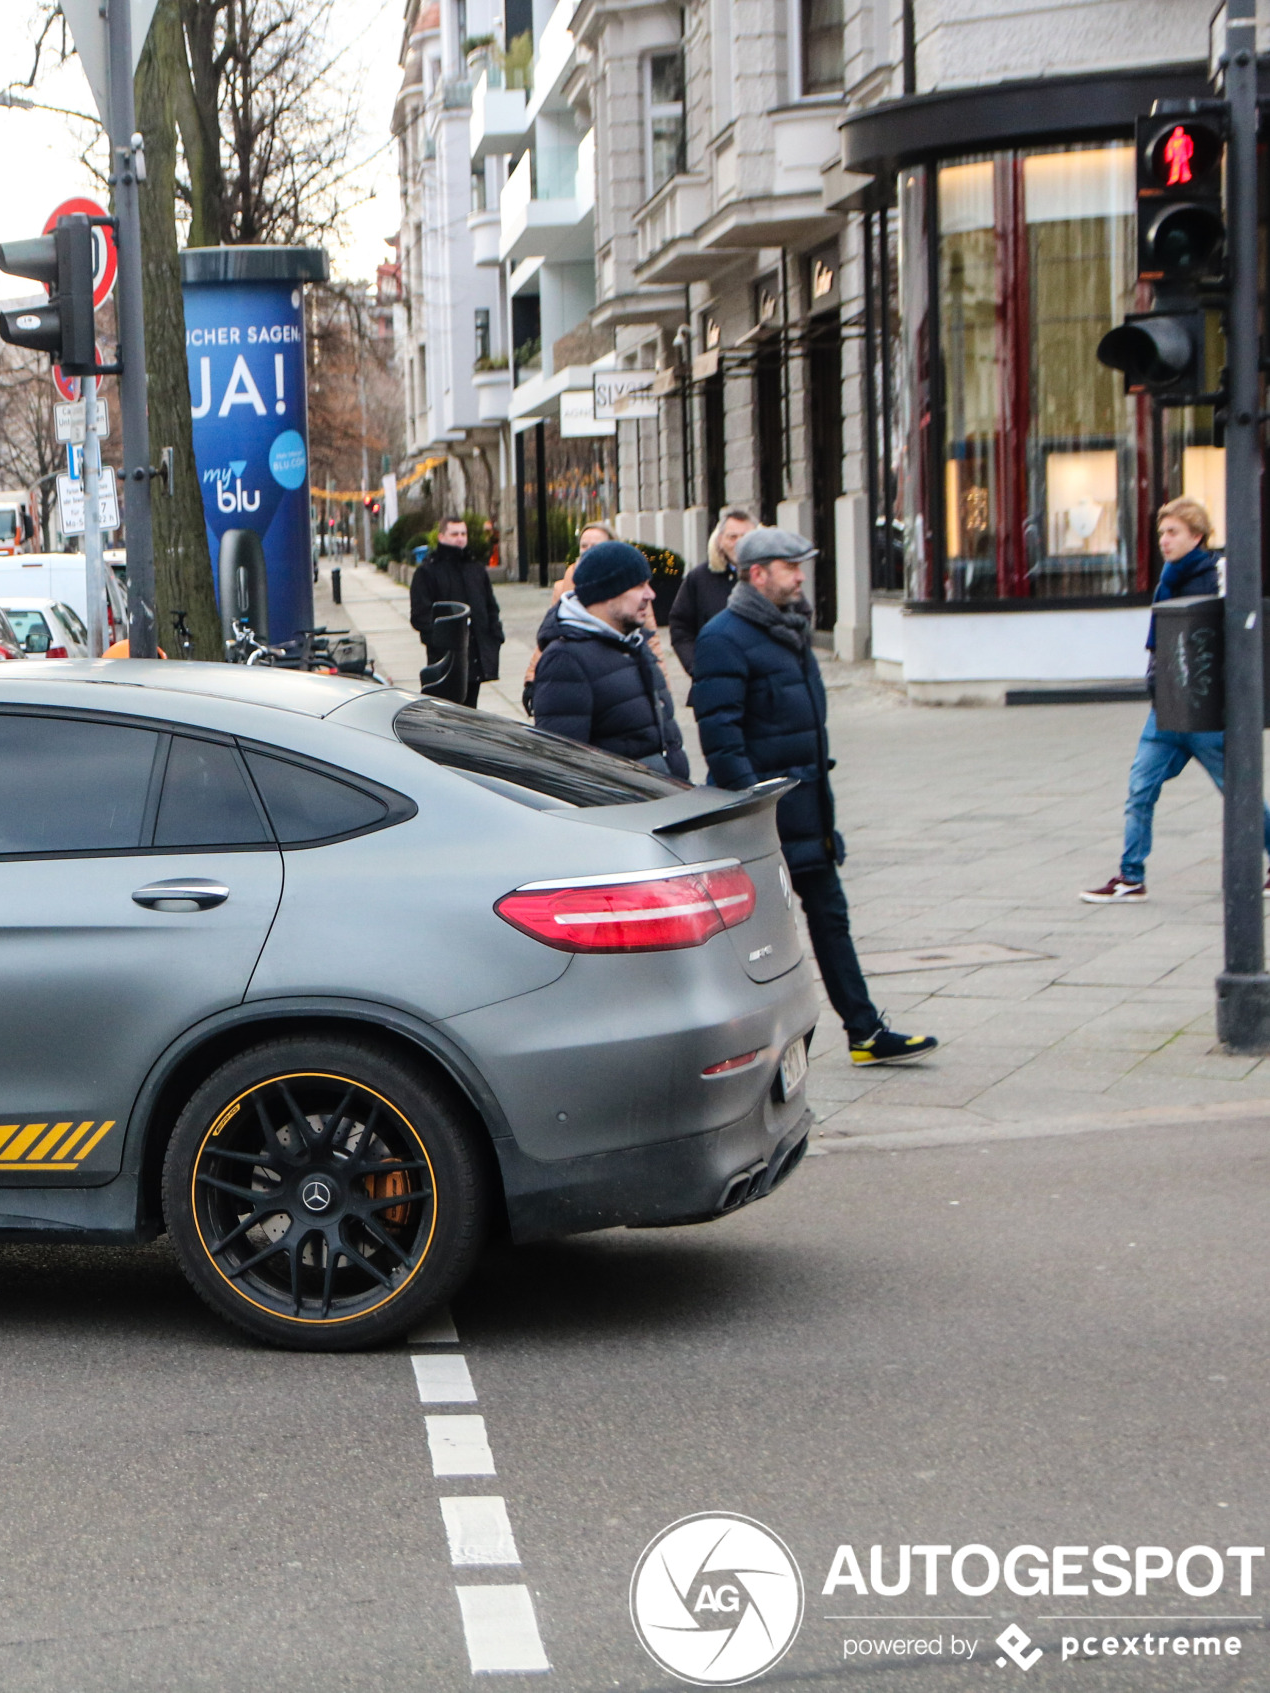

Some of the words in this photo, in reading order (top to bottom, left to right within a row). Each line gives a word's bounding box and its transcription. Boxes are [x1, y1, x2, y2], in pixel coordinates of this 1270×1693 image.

[191, 353, 287, 420] JA!
[203, 467, 232, 490] my
[216, 478, 261, 514] blu
